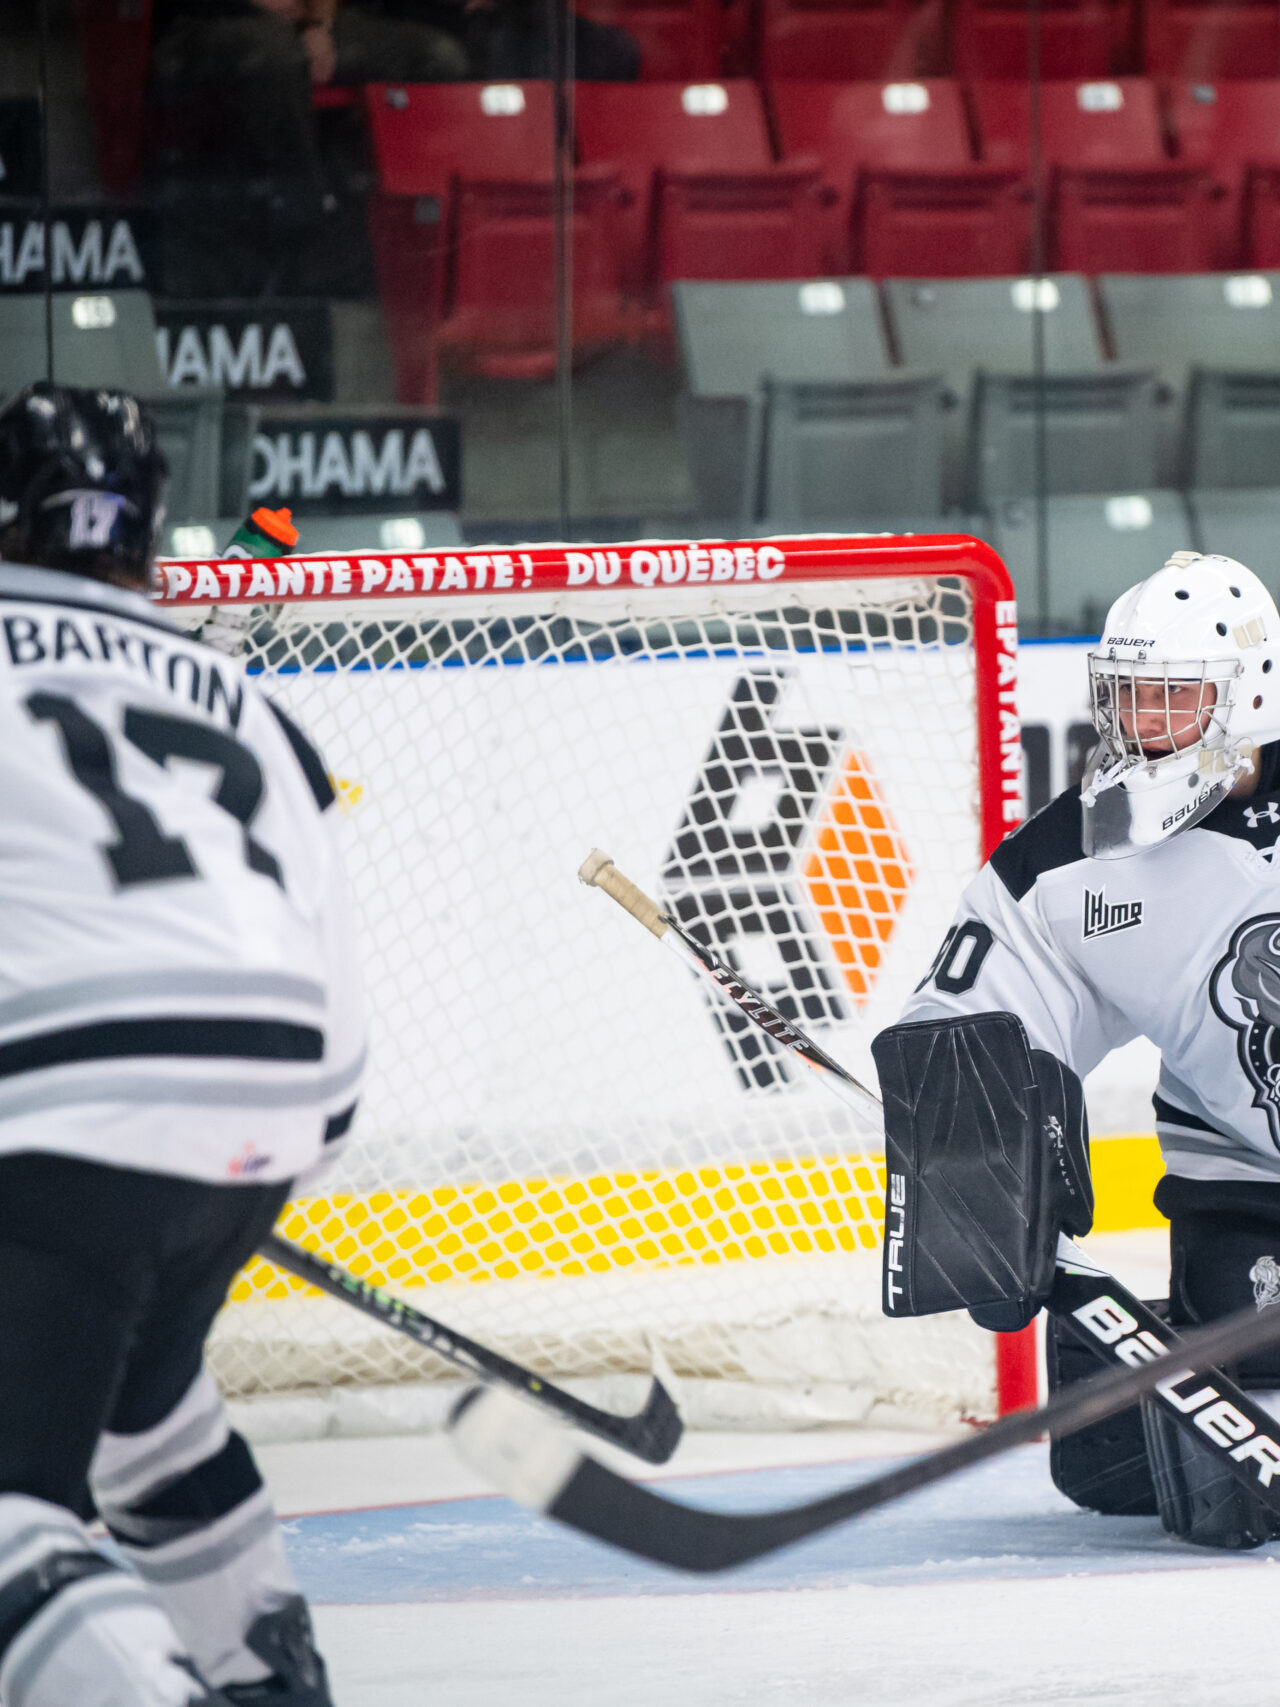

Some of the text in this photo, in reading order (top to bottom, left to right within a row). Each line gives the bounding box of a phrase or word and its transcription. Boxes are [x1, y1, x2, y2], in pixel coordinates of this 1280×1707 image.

[564, 552, 621, 586] DU
[3, 615, 244, 731] BARTON
[22, 688, 289, 895] 17
[888, 1173, 906, 1310] TRUE
